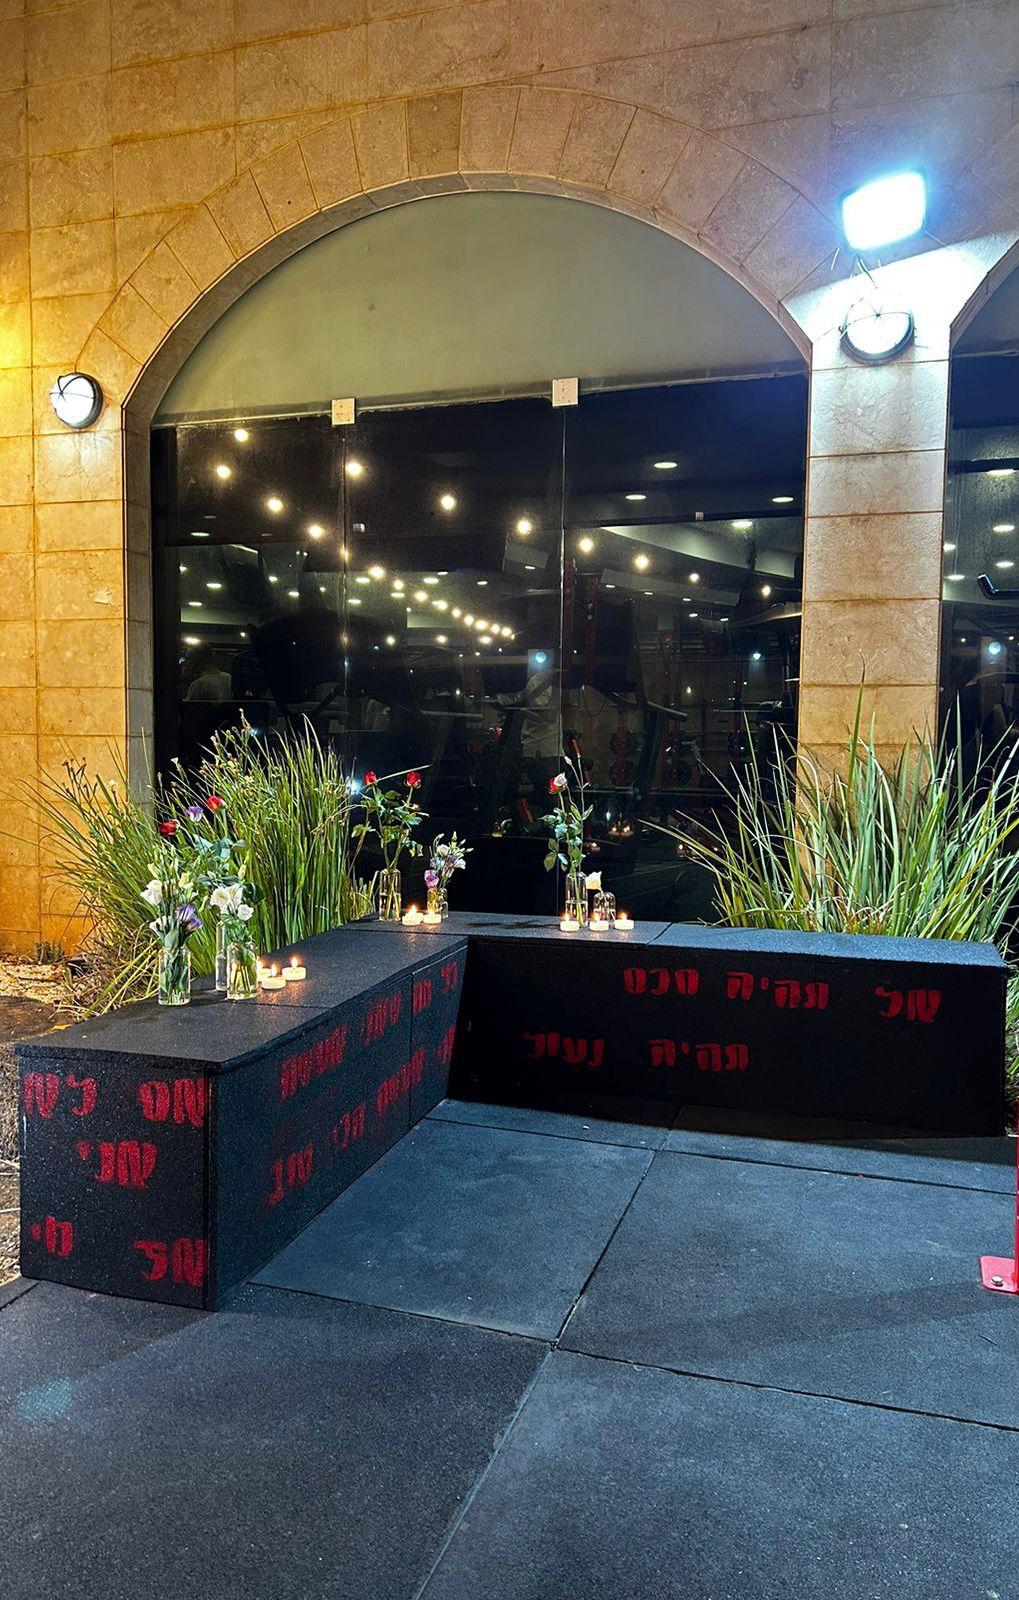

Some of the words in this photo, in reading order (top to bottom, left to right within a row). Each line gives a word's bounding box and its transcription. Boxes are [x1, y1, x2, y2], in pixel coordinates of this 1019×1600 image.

[622, 967, 700, 996] חכם
[726, 971, 830, 1009] תהיה
[873, 986, 942, 1024] אל
[648, 1038, 749, 1072] תהיה
[23, 1072, 97, 1119] לא
[137, 1077, 208, 1128] אם
[76, 1139, 158, 1189] אני
[31, 1216, 74, 1257] מי
